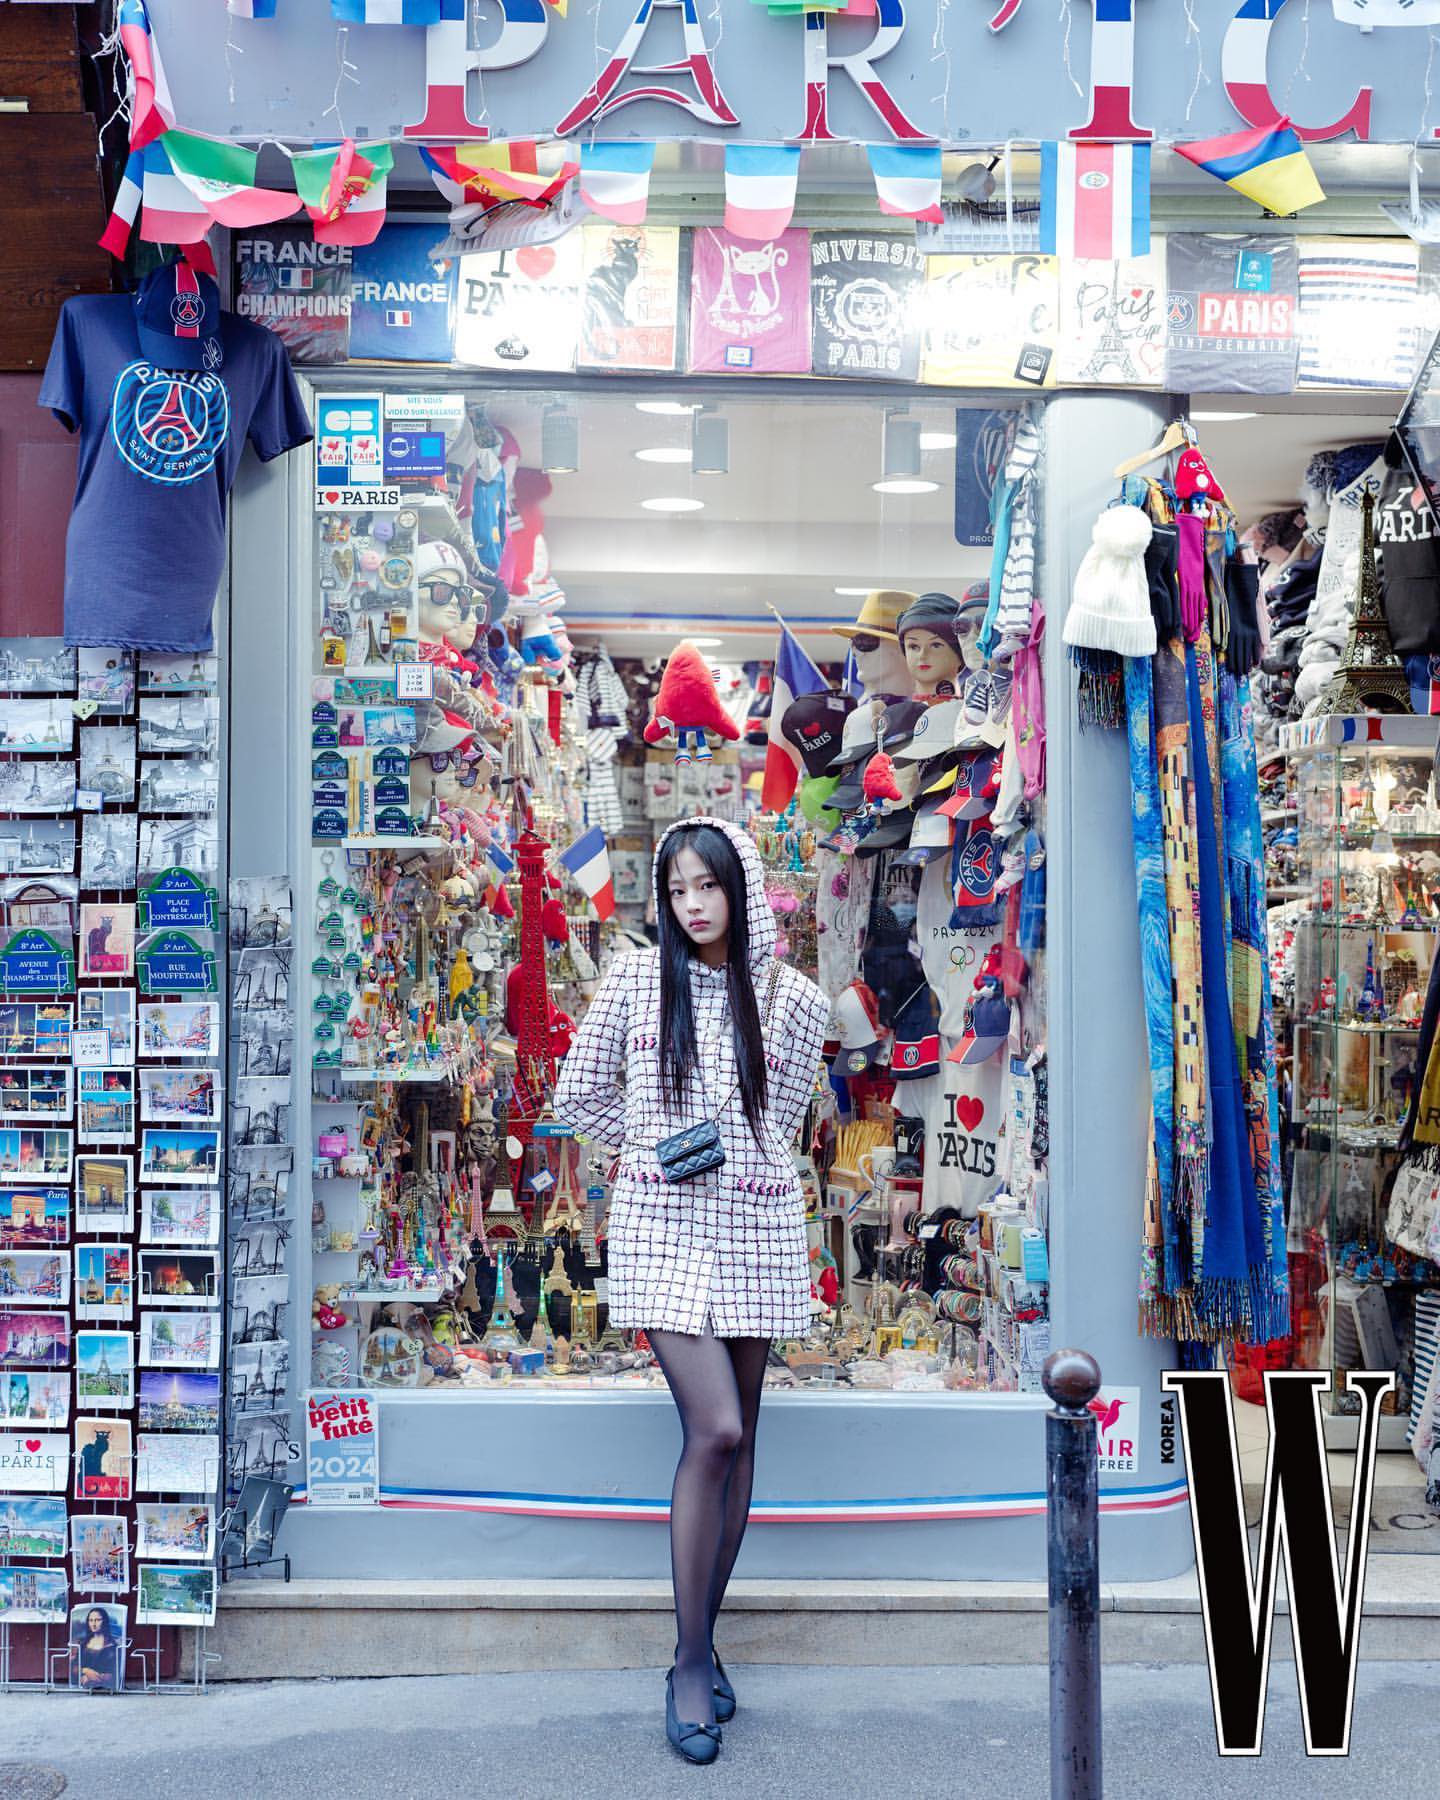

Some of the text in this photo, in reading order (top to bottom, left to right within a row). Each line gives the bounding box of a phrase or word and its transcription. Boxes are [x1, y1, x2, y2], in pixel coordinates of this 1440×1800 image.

[235, 240, 352, 265] FRANCE
[351, 282, 448, 304] FRANCE
[236, 294, 352, 317] CHAMPIONS
[1203, 298, 1290, 334] PARIS
[827, 343, 901, 370] PARIS
[133, 366, 219, 394] PARIS
[317, 490, 399, 505] I PARIS
[794, 728, 807, 743] I
[802, 731, 832, 751] PARIS
[962, 843, 978, 886] PARIS
[943, 1093, 958, 1128] I
[47, 1191, 68, 1200] Paris
[309, 1398, 369, 1429] petit
[321, 1416, 374, 1441] futé
[15, 1439, 25, 1453] I
[1, 1455, 56, 1469] PARIS
[310, 1456, 376, 1479] 2024
[1099, 1460, 1134, 1470] FREE
